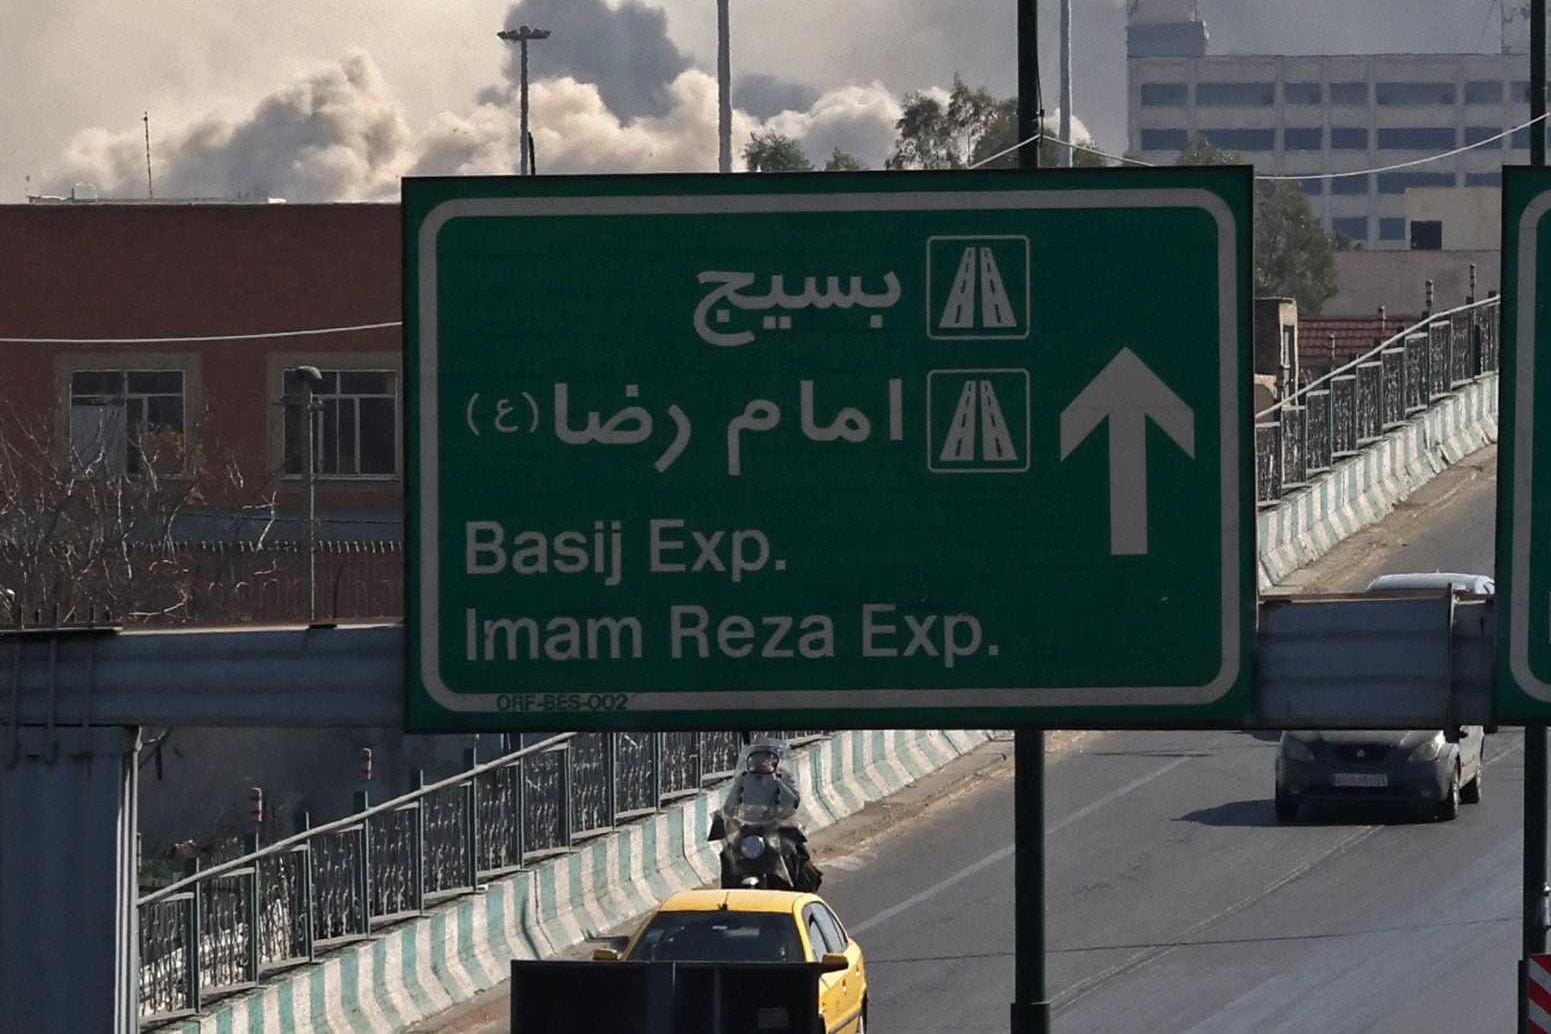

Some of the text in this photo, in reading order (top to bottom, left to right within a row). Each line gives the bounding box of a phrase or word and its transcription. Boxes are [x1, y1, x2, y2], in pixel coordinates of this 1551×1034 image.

[693, 270, 901, 347] بسیج
[727, 377, 904, 476] امام
[465, 518, 787, 586] Basij Exp.
[466, 603, 1000, 668] Imam Reza Exp.
